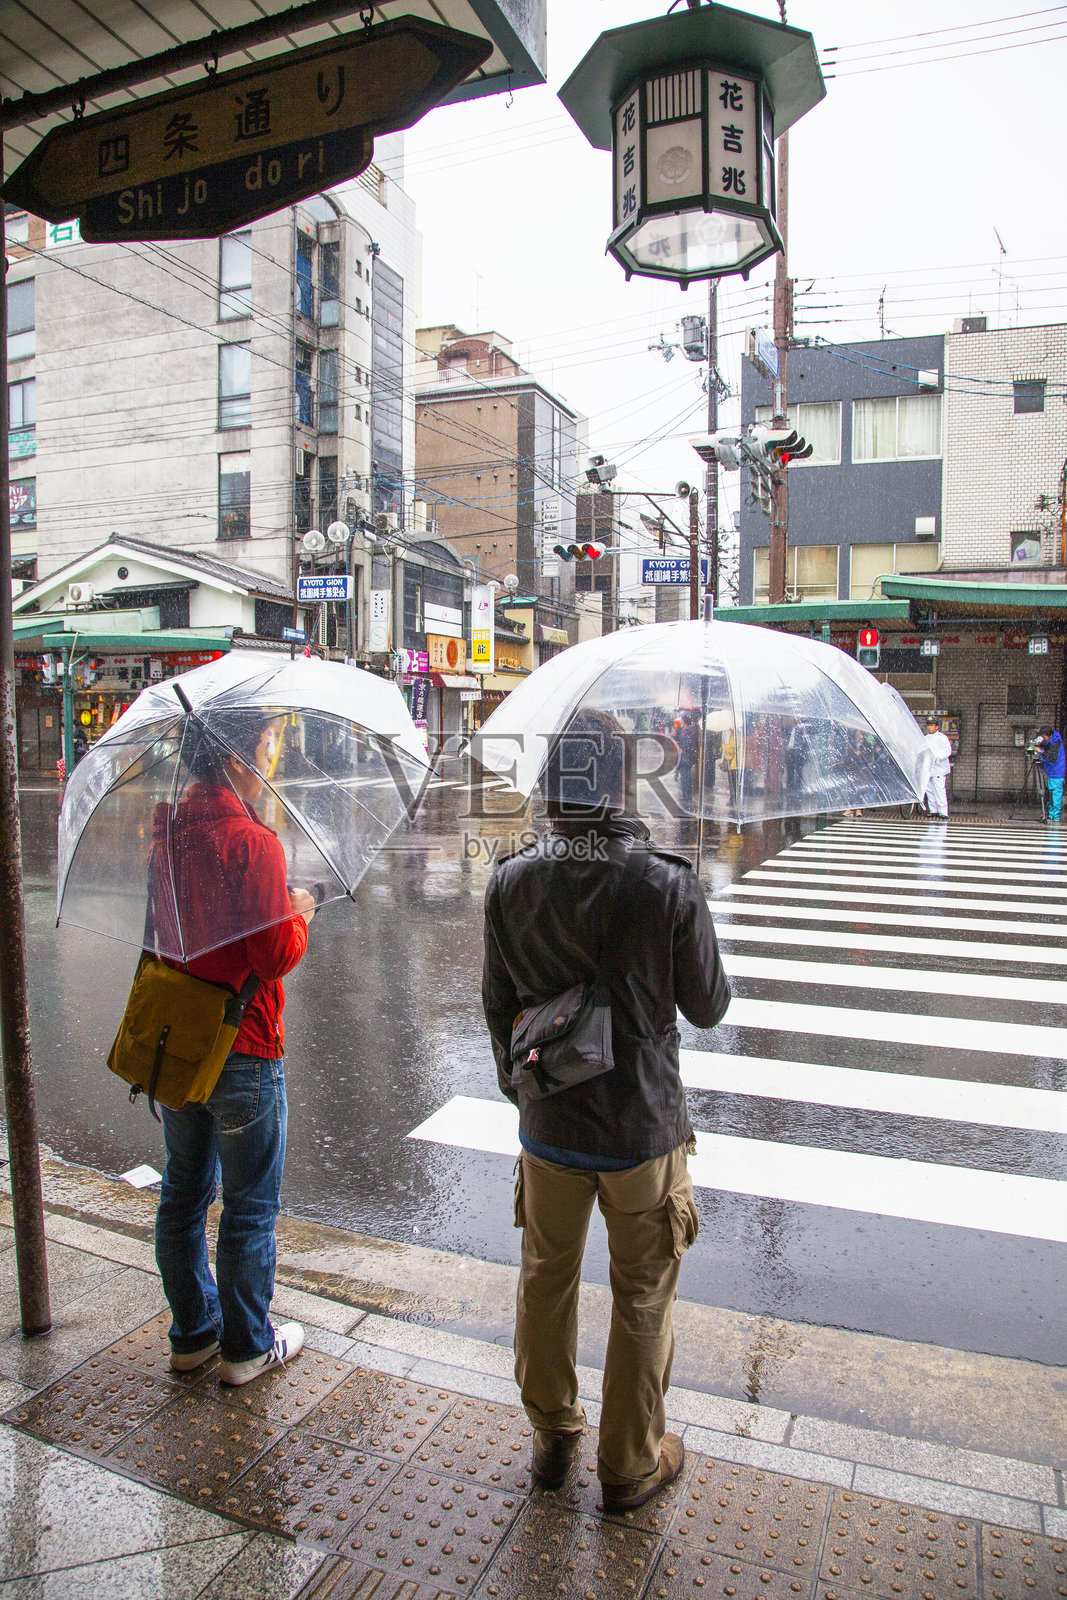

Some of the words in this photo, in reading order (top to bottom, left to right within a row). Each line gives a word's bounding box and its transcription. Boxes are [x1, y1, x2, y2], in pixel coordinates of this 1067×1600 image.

[99, 66, 346, 177] 四条通り
[622, 102, 636, 219] 花吉兆
[719, 80, 746, 195] 花吉兆
[649, 560, 677, 569] KYOTO
[680, 560, 690, 569] GI
